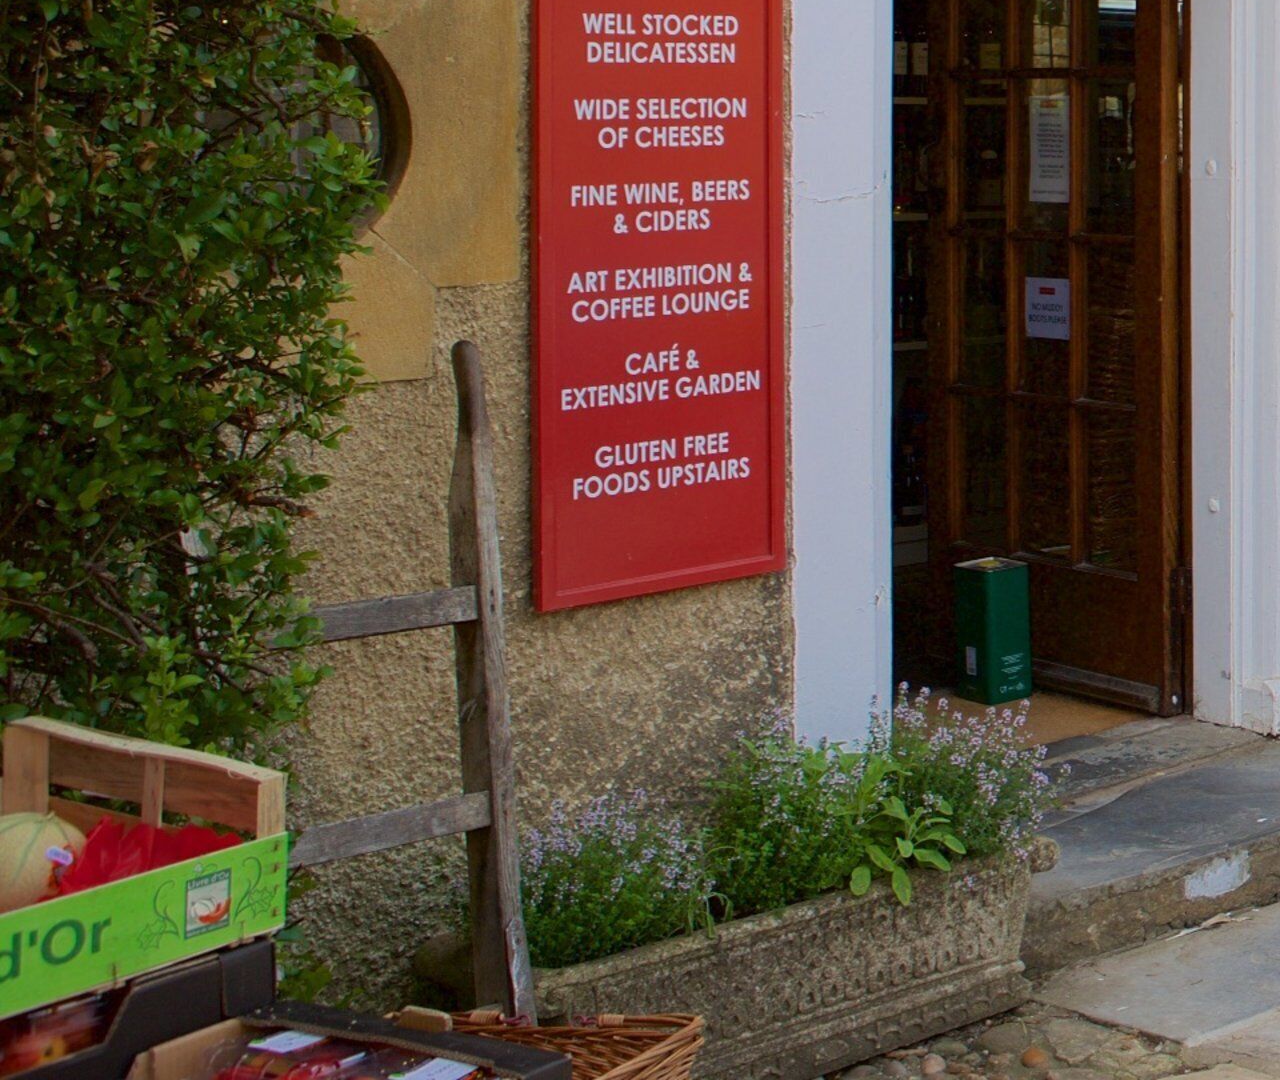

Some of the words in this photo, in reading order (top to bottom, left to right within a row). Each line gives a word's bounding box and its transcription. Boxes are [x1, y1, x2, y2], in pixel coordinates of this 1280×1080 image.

[583, 13, 635, 35] WELL
[642, 14, 739, 36] STOCKED
[587, 42, 736, 64] DELICATESSEN
[574, 99, 630, 120] WIDE
[636, 97, 747, 120] SELECTION
[598, 127, 629, 149] OF
[635, 125, 725, 148] CHEESES
[570, 185, 618, 207] FINE
[624, 183, 684, 206] WINE,
[691, 180, 750, 202] BEERS
[613, 214, 628, 234] &
[635, 209, 711, 232] CIDERS
[567, 270, 608, 294] ART
[615, 263, 731, 290] EXHIBITION
[738, 262, 752, 283] &
[571, 298, 656, 322] COFFEE
[662, 289, 750, 316] LOUNGE
[625, 344, 680, 376] CAFÉ
[685, 349, 700, 369] &
[561, 379, 669, 411] EXTENSIVE
[675, 370, 760, 397] GARDEN
[594, 438, 677, 468] GLUTEN
[684, 432, 729, 456] FREE
[572, 470, 650, 500] FOODS
[657, 457, 750, 489] UPSTAIRS
